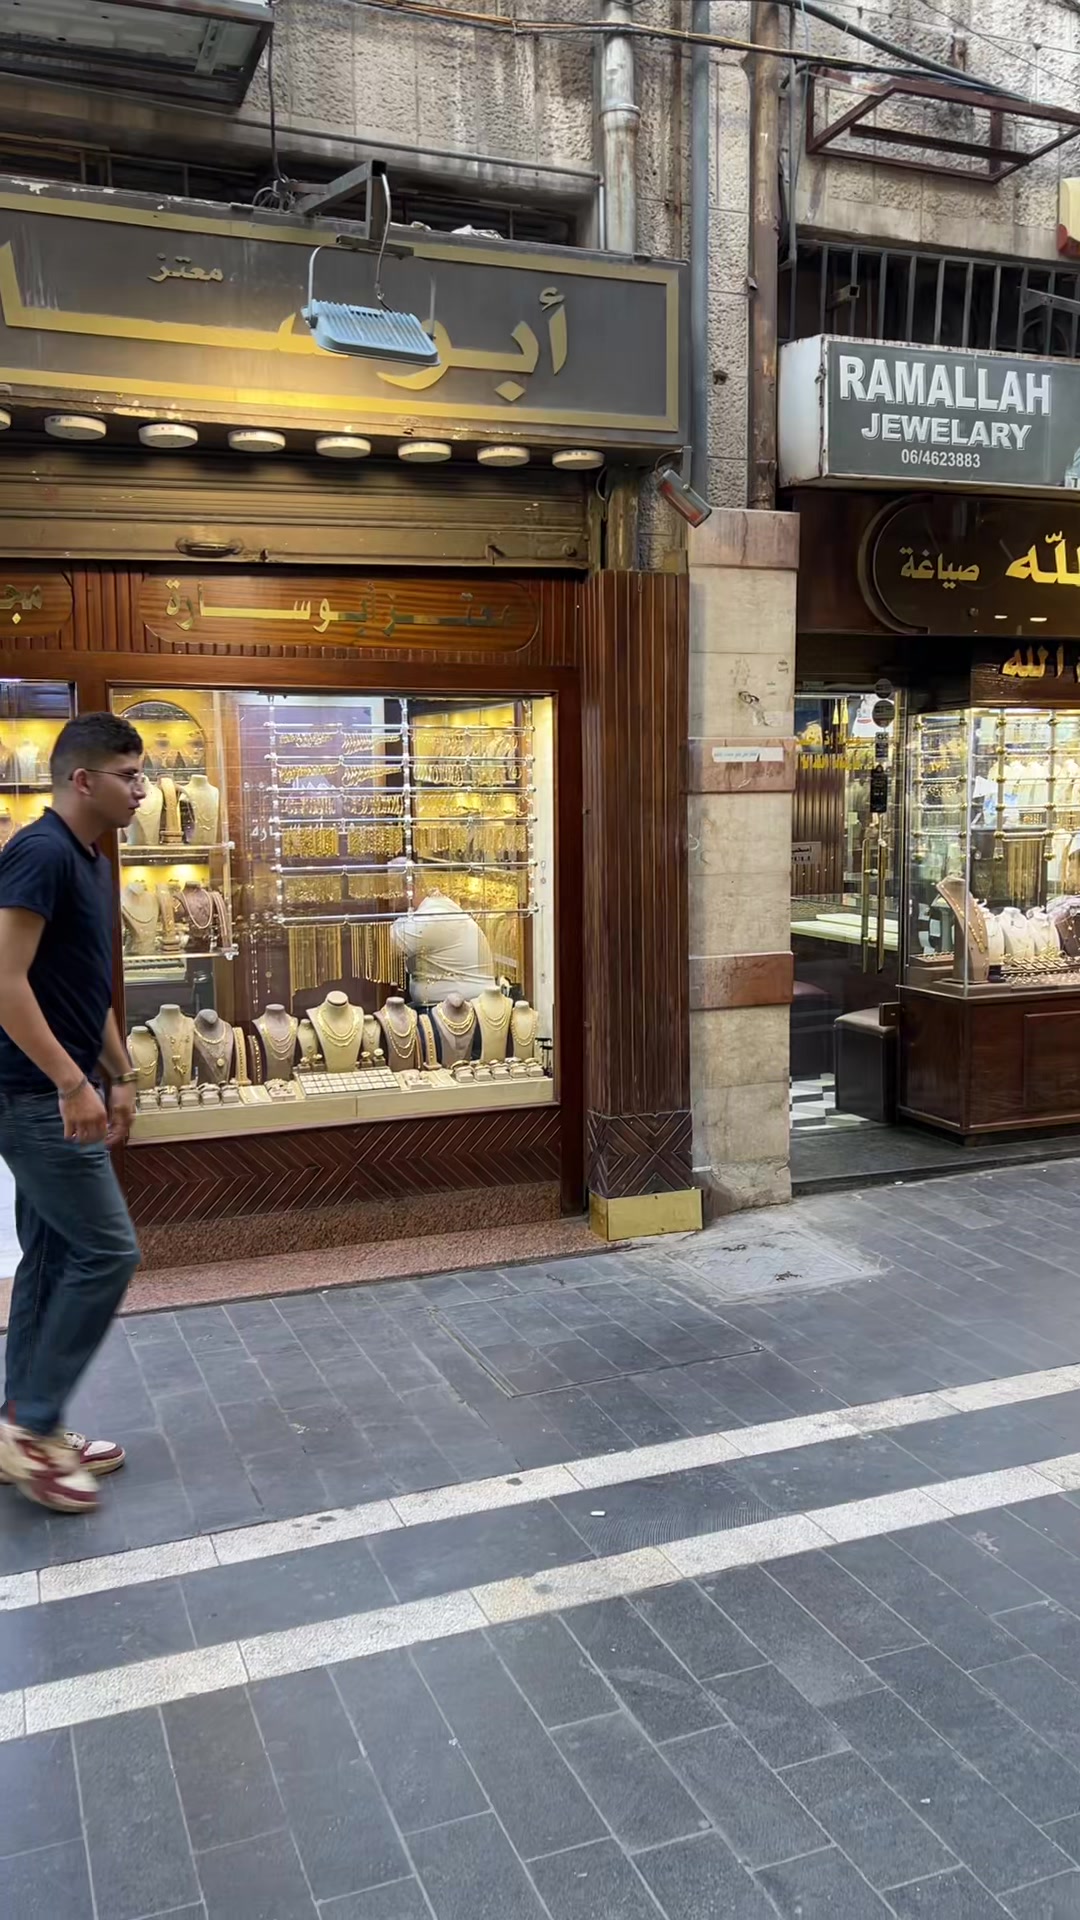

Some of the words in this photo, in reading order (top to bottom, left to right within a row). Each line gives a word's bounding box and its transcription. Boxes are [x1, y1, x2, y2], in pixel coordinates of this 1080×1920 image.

[148, 253, 224, 282] معتز
[839, 355, 1052, 416] RAMALLAH
[861, 413, 1032, 450] JEWELARY
[901, 449, 981, 468] 06/4623883
[900, 547, 980, 589] صياغة
[165, 578, 311, 631] سارة
